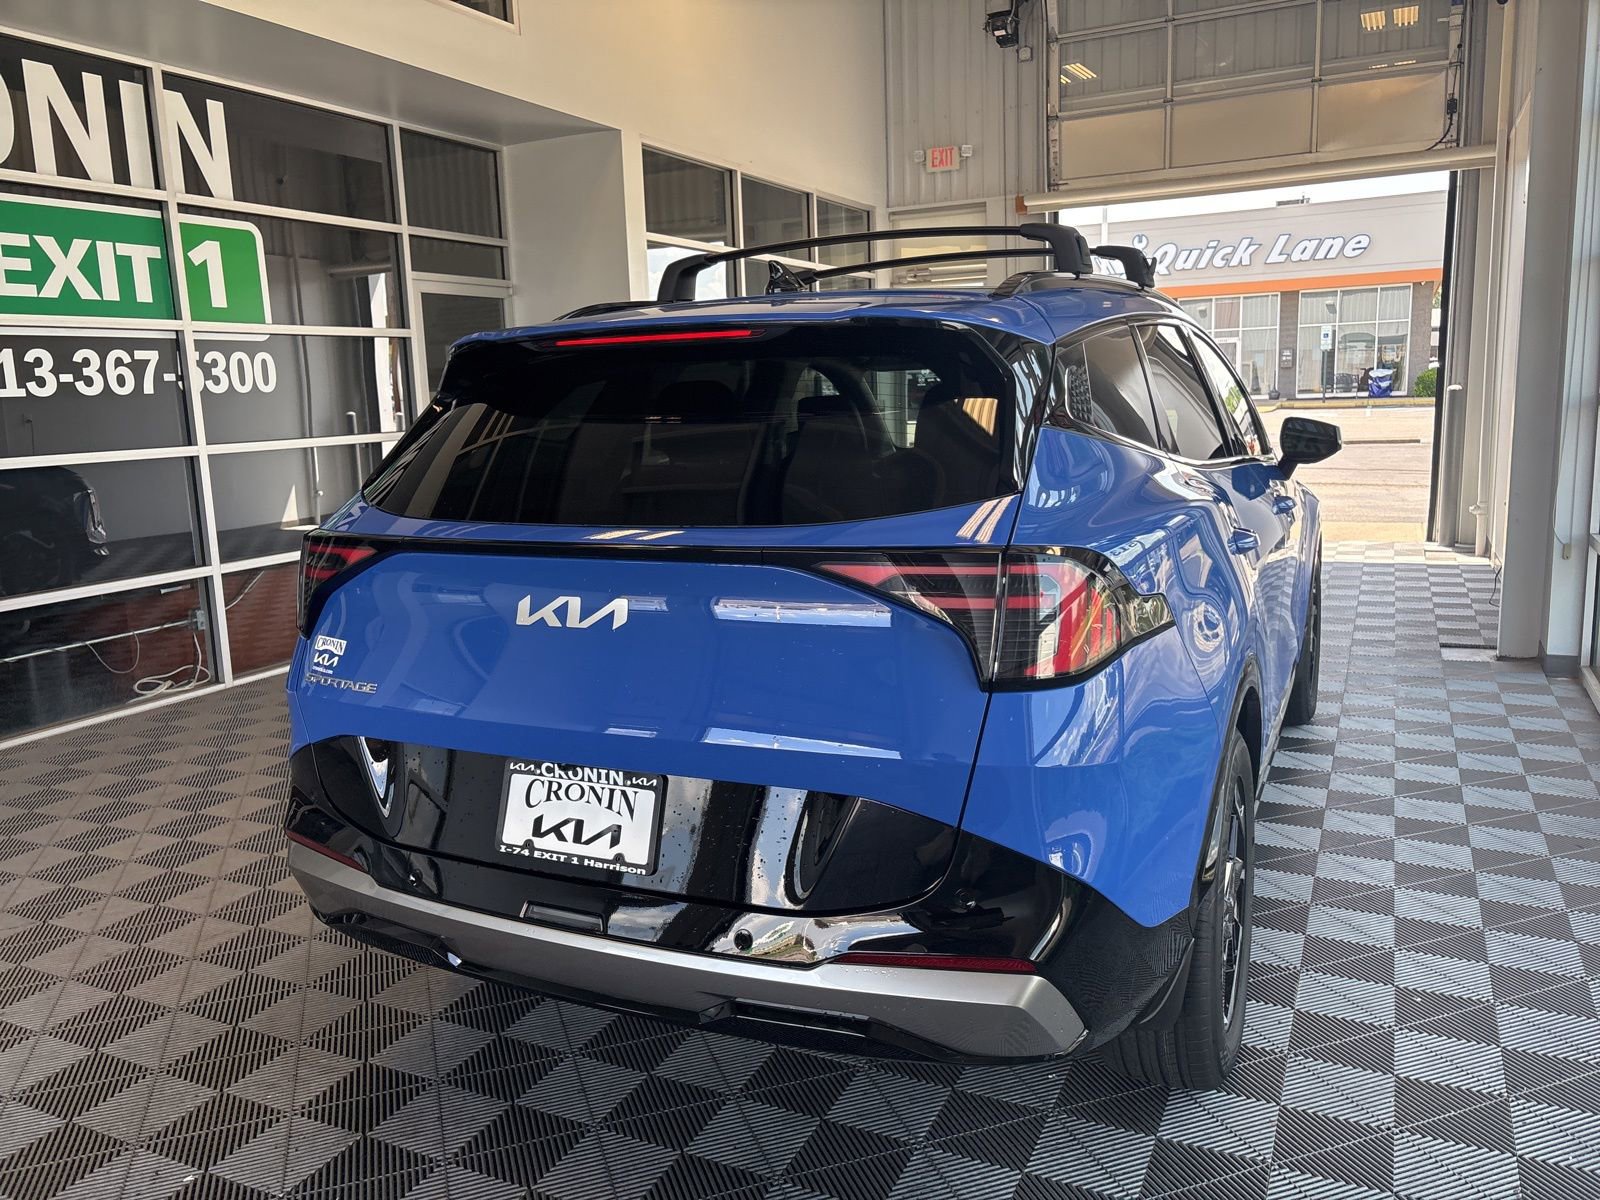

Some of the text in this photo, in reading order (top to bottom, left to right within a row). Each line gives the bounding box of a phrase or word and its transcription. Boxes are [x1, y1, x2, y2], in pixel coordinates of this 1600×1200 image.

[0, 58, 234, 200] NIN
[931, 148, 954, 168] EXIT
[0, 232, 228, 309] EXIT 1
[1150, 233, 1372, 276] Quick Lane
[516, 594, 628, 630] KIA
[313, 652, 339, 667] KIA
[317, 637, 345, 653] CRONIN
[306, 673, 377, 694] SPORTAGE
[525, 778, 638, 822] CRONIN
[531, 813, 622, 849] KIA
[499, 844, 647, 876] I-74 EXIT 1 Harrison
